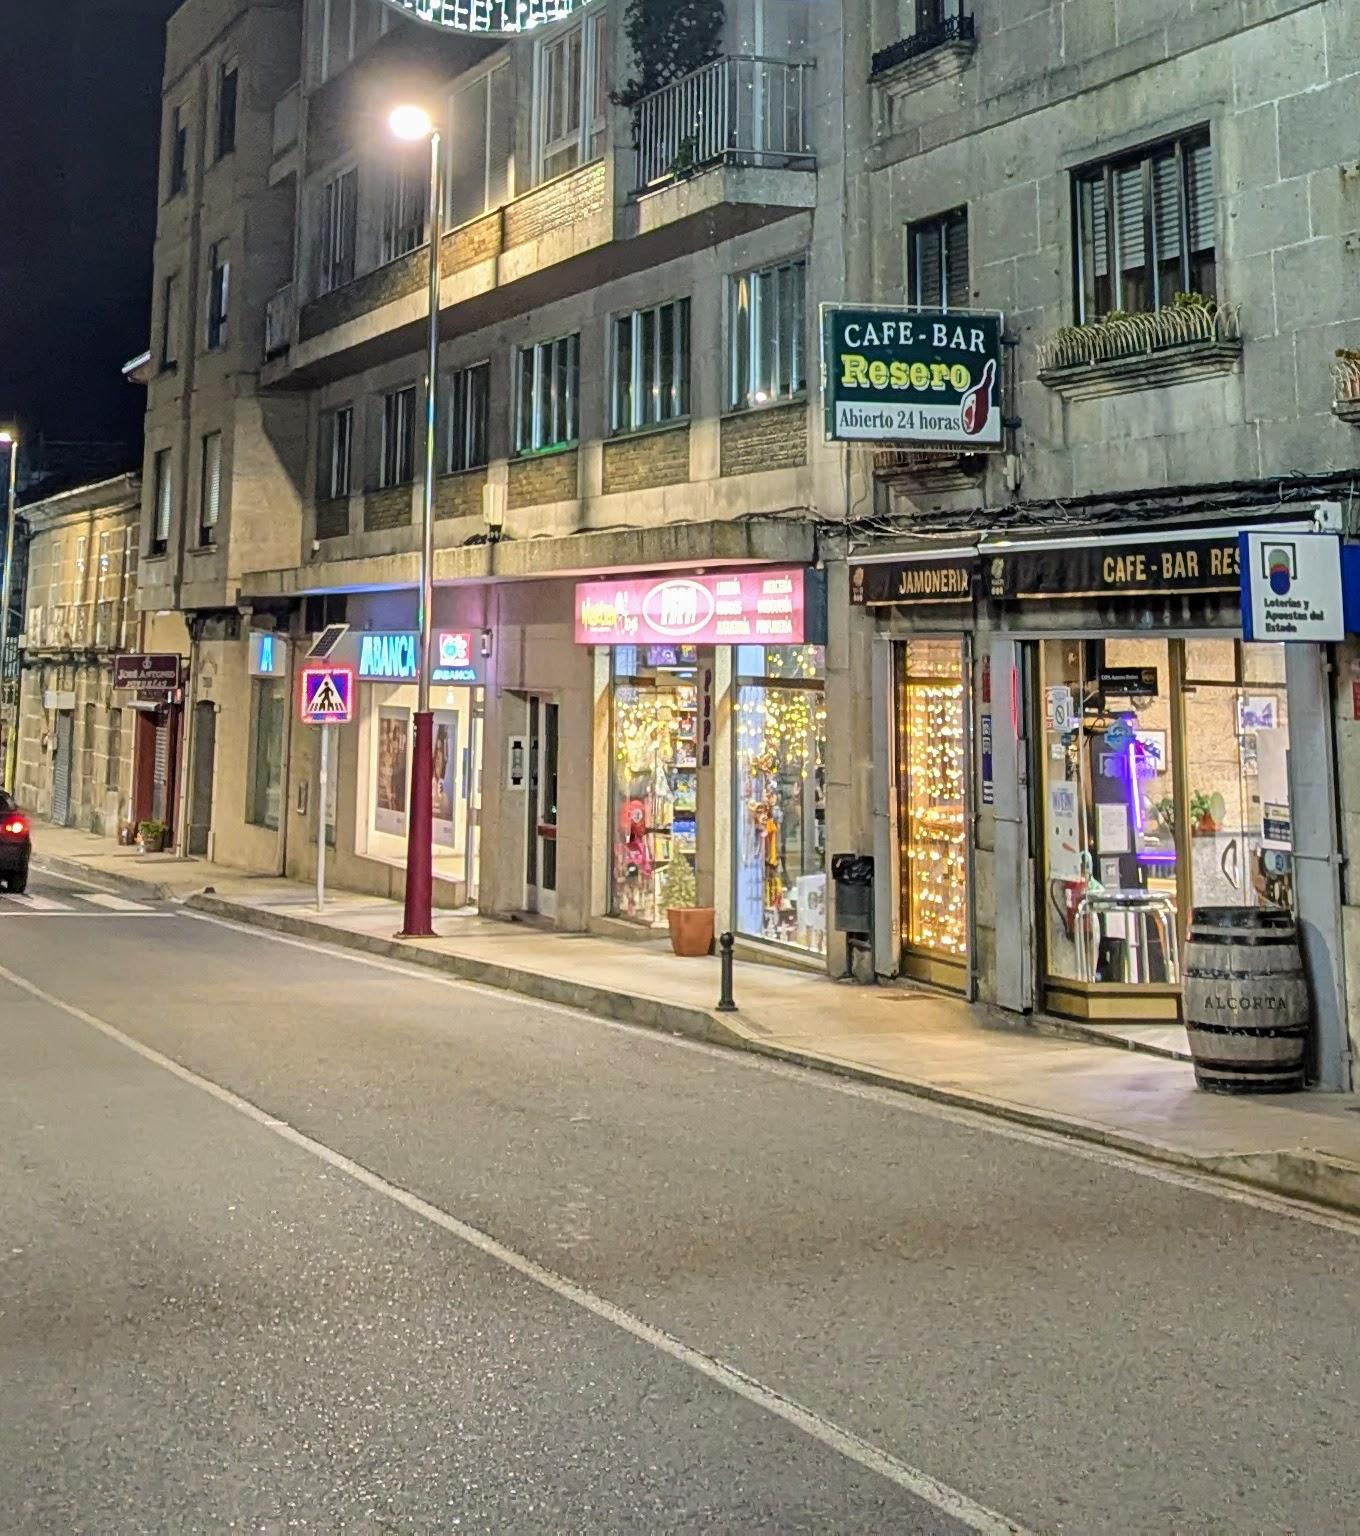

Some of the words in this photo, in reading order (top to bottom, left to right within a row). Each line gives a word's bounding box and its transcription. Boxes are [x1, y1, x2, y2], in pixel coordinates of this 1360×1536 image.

[841, 354, 971, 392] Resero
[840, 408, 893, 429] Abierto
[897, 410, 915, 429] 24
[919, 411, 961, 431] horas
[1303, 600, 1309, 611] y
[1265, 622, 1298, 632] Estado
[359, 636, 416, 677] ABANCA
